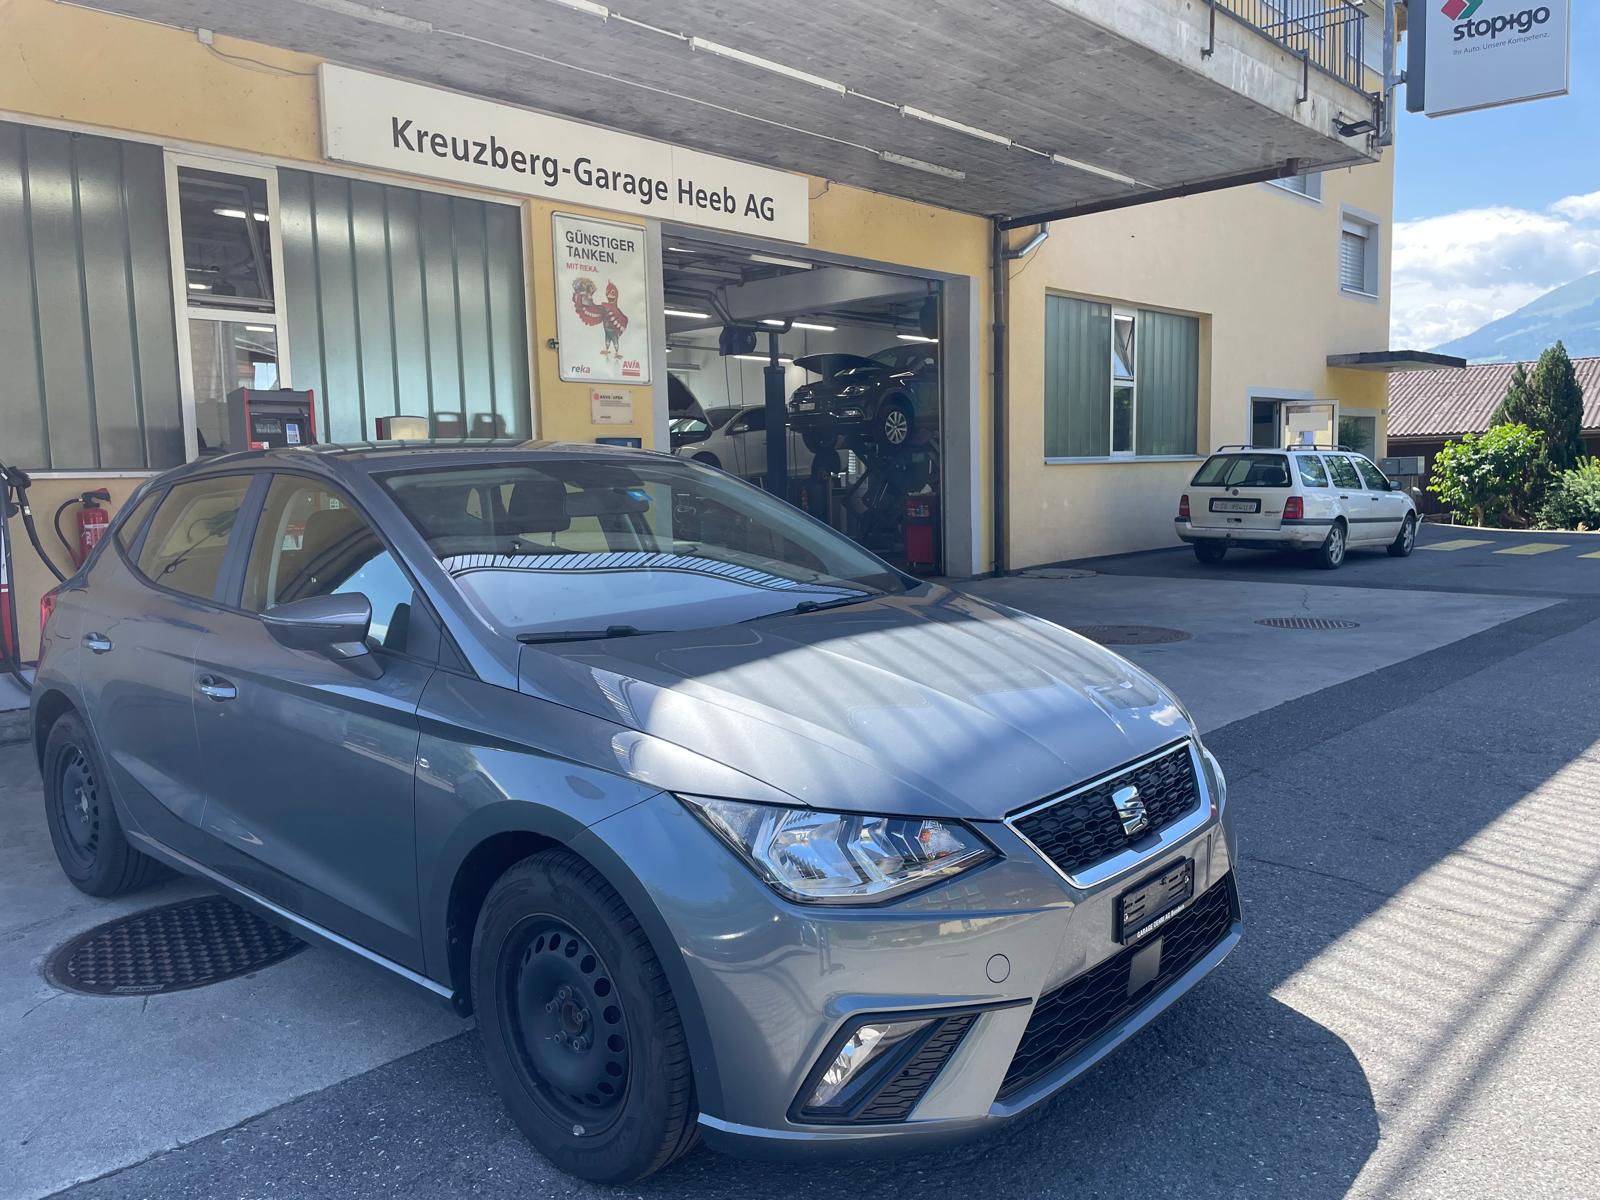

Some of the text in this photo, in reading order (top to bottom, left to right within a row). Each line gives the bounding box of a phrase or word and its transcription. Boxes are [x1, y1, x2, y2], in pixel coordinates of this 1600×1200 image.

[1453, 6, 1550, 41] stop+go
[1452, 32, 1550, 56] Ihr Auto. Unsere Kompetenz.
[391, 116, 776, 222] Kreuzberg-Garage Heeb AG
[566, 229, 635, 252] GÜNSTIGER
[566, 245, 618, 264] TANKEN.
[566, 262, 578, 270] MIT
[571, 364, 591, 374] reka
[622, 360, 640, 370] AVIA
[1136, 923, 1153, 938] GARAGE
[1165, 911, 1171, 921] AG
